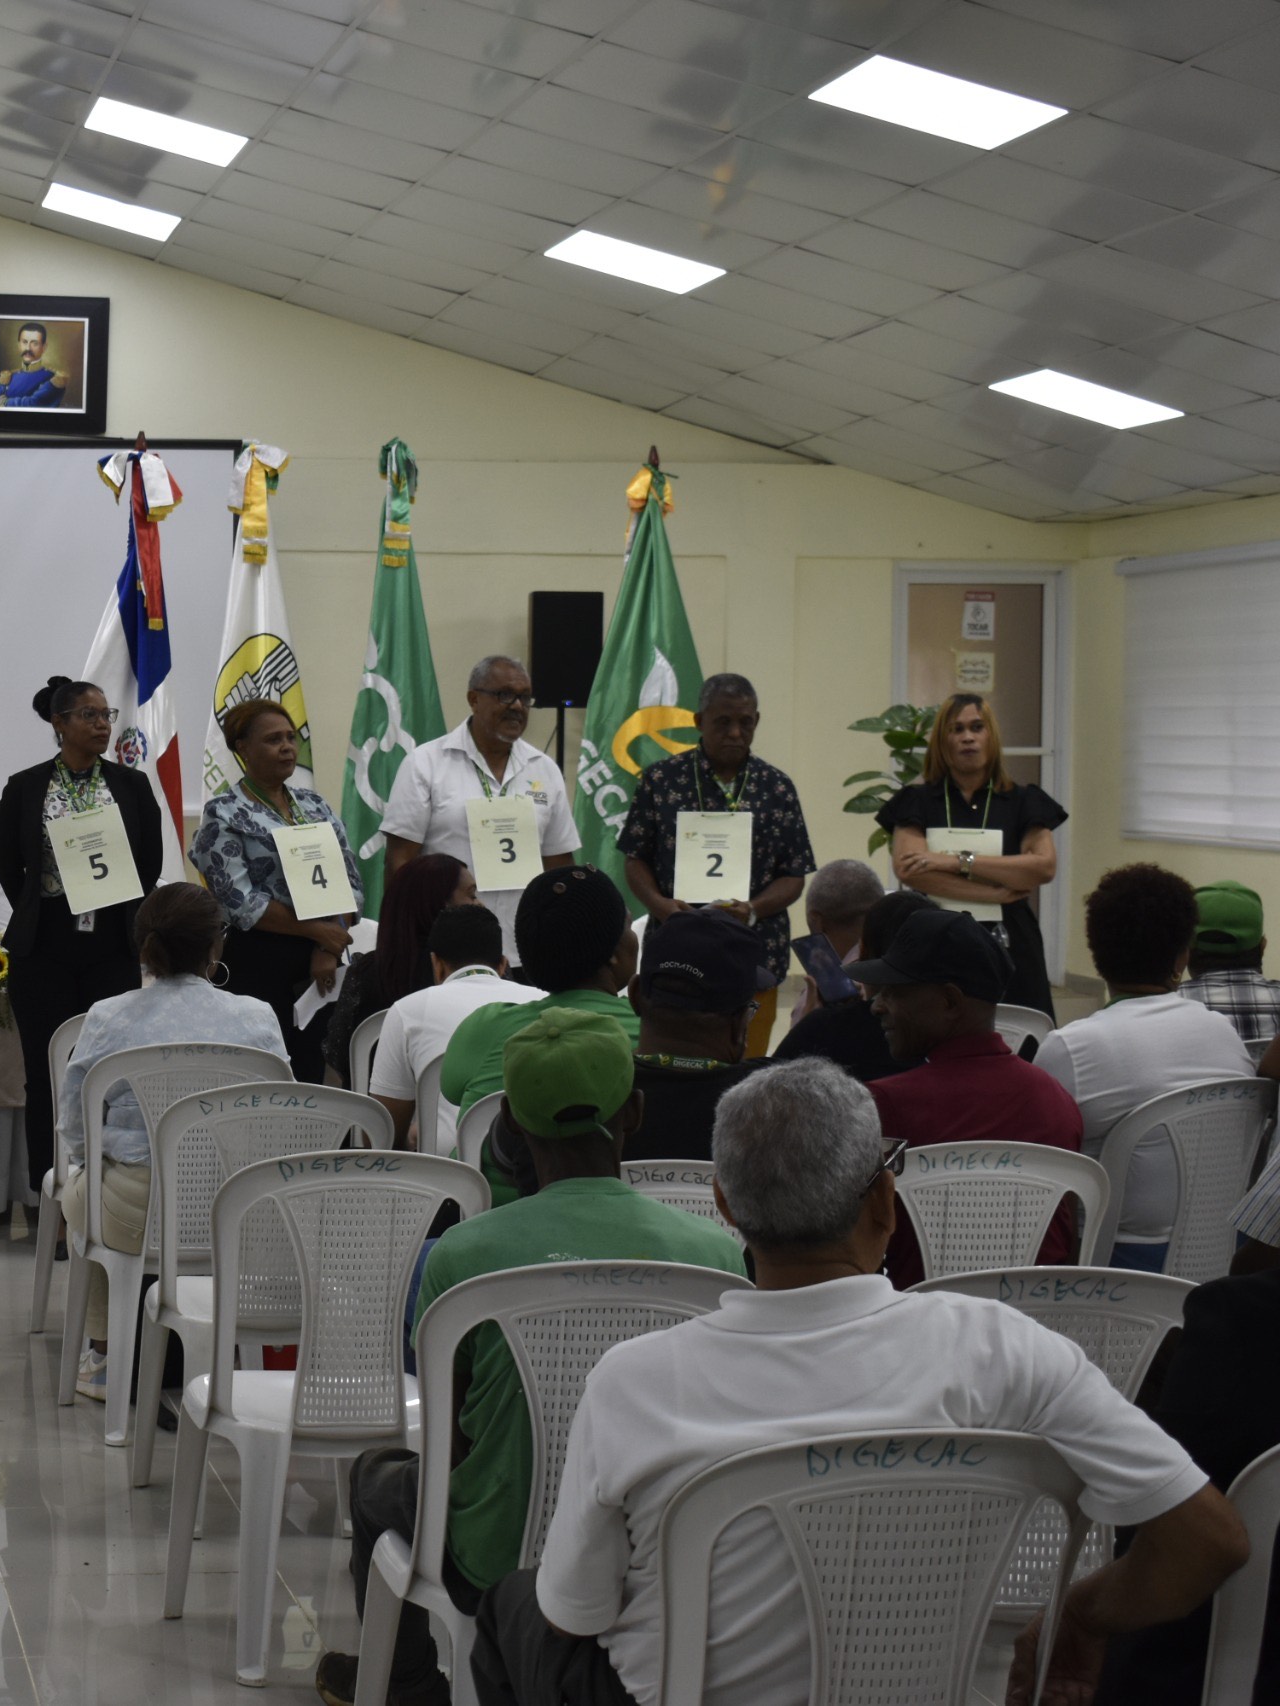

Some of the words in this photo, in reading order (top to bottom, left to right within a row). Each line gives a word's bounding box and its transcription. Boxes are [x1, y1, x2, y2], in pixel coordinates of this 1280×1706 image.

[499, 837, 517, 864] 3
[88, 852, 109, 880] 5
[311, 864, 328, 889] 4
[705, 853, 723, 878] 2
[672, 1059, 704, 1069] DIGECAC
[199, 1092, 318, 1116] DIGECAC
[278, 1154, 403, 1182] DIGECAC
[919, 1151, 1024, 1174] DIGECAC
[999, 1273, 1129, 1302] DIGECAC
[806, 1437, 988, 1478] DIGECAC
